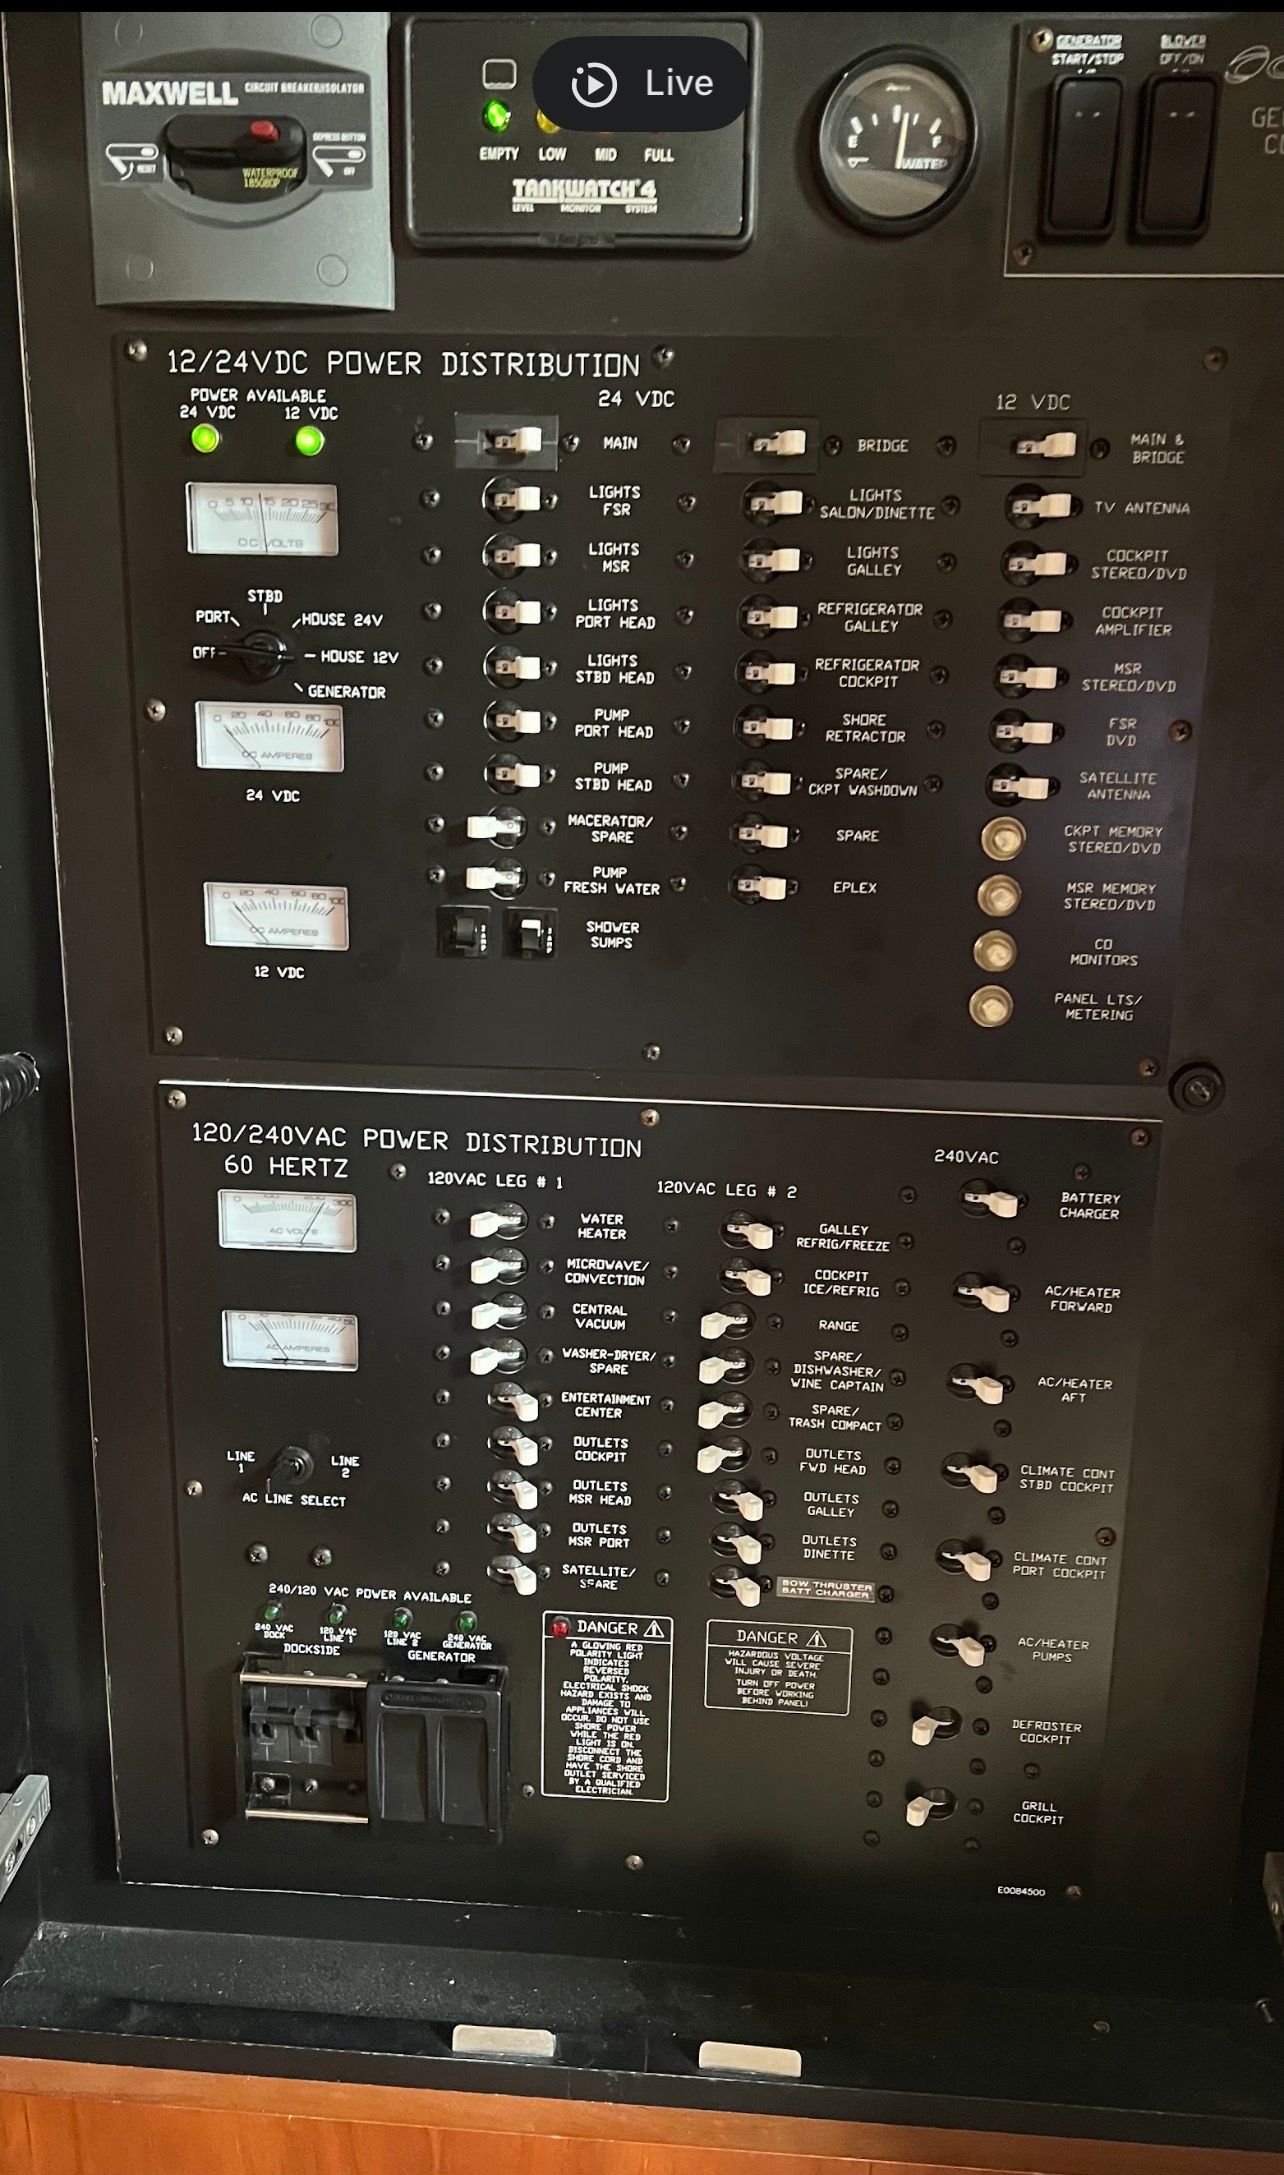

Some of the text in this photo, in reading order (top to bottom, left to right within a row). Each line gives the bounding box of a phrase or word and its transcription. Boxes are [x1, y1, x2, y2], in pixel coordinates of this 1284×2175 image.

[103, 81, 238, 105] MAXWELL
[245, 82, 278, 93] CIRCUIT
[480, 147, 674, 162] EMPTY LOW MID FULL
[169, 349, 639, 377] 12/24VDC POWER DISTRIBUTION
[191, 388, 326, 403] POWER AVAILABLE
[599, 390, 674, 407] 24 VDC
[997, 394, 1070, 410] 12 VDC
[180, 405, 235, 419] 24 VDC
[285, 406, 338, 420] 12 VDC
[604, 436, 637, 449] MAIN
[1131, 433, 1184, 445] MAIN &
[858, 439, 908, 452] BRIDGE
[1133, 451, 1184, 464] BRIDGE
[590, 485, 640, 499] LIGHTS
[850, 489, 901, 501] LIGHTS
[604, 503, 630, 516] FSR
[821, 506, 935, 519] SALON/DINETTE
[1096, 501, 1190, 514] TV ANTENNA
[1107, 549, 1168, 562] COCKPIT
[1092, 567, 1187, 580] STEREO/DVD
[248, 589, 282, 603] STBD
[818, 603, 923, 616] REFRIGERATOR
[196, 610, 230, 623] PORT
[302, 613, 383, 626] HOUSE 24V
[845, 620, 898, 632] GALLEY
[321, 650, 399, 663] HOUSE 12V
[308, 685, 386, 699] GENERATOR
[595, 709, 629, 721] PUMP
[843, 714, 886, 726] SHORE
[575, 725, 653, 738] PORT HEAD
[826, 730, 905, 743] RETRACTOR
[836, 768, 887, 780] SPARE/
[1080, 772, 1157, 785] SATELLITE
[247, 789, 300, 802] 24 VDC
[809, 784, 917, 796] CKPT WASHDOWN
[1088, 789, 1150, 800] ANTENNA
[568, 814, 653, 827] MACERATOR/
[592, 831, 633, 843] SPARE
[593, 866, 627, 878] PUMP
[564, 881, 660, 895] FRESH WATER
[834, 882, 876, 893] EPLEX
[587, 921, 639, 933] SHOWER
[591, 936, 632, 948] SUMPS
[1095, 939, 1112, 950] CO
[1071, 954, 1138, 966] MONITORS
[255, 966, 304, 978] 12 VDC
[1055, 993, 1142, 1005] PANEL LTS/
[1066, 1009, 1133, 1021] METERING
[193, 1123, 641, 1157] 120/240VAC POWER DISTRIBUTION
[935, 1149, 998, 1164] 240VAC
[225, 1155, 348, 1178] 60 HERTZ
[429, 1171, 562, 1189] 120VAC LEG # 1
[658, 1181, 797, 1198] 120VAC LEG # 2
[1062, 1192, 1120, 1204] BATTERY
[581, 1213, 623, 1225] WATER
[1060, 1207, 1119, 1219] CHARGER
[578, 1228, 626, 1239] HEATER
[820, 1224, 868, 1235] GALLEY
[797, 1237, 890, 1251] REFRIG/FREEZE
[567, 1258, 649, 1271] MICROWAVE/
[565, 1273, 644, 1285] CONVECTION
[1045, 1286, 1120, 1298] AC/HEATER
[573, 1303, 627, 1316] CENTRAL
[1051, 1301, 1112, 1313] FORWARD
[576, 1318, 625, 1330] VACUUM
[819, 1320, 859, 1331] RANGE
[815, 1351, 862, 1362] SPARE/
[794, 1364, 881, 1377] DISHWASHER/
[791, 1378, 883, 1392] WINE CAPTAIN
[562, 1392, 651, 1405] ENTERTAINMENT
[575, 1407, 622, 1418] CENTER
[227, 1451, 255, 1462] LINE
[332, 1456, 359, 1466] LINE
[239, 1463, 243, 1473] 1
[342, 1468, 350, 1478] 2
[243, 1493, 346, 1507] AC LINE SELECT
[573, 1523, 626, 1534] OUTLETS
[569, 1536, 630, 1548] MSR PORT
[812, 1581, 873, 1591] THRUSTER
[269, 1583, 471, 1603] 240/120 VAC POWER AVAILABLE
[816, 1589, 869, 1598] CHARGER
[578, 1620, 638, 1634] DANGER
[737, 1630, 798, 1644] DANGER
[284, 1643, 340, 1655] DOCKSIDE
[582, 1641, 621, 1650] GLOWING
[1019, 1638, 1089, 1649] AC/HEATER
[408, 1650, 475, 1662] GENERATOR
[570, 1649, 643, 1660] POLARITY LIGHT
[729, 1650, 824, 1662] HAZARDOUS VOLTAGE
[1033, 1652, 1072, 1662] PUMPS
[725, 1658, 820, 1670] WILL CAUSE SEVERE
[583, 1666, 629, 1675] REVERSED
[1012, 1720, 1081, 1732] DEFROSTER
[1020, 1733, 1071, 1744] COCKPIT
[1022, 1801, 1056, 1812] GRILL
[1014, 1813, 1064, 1824] COCKPIT
